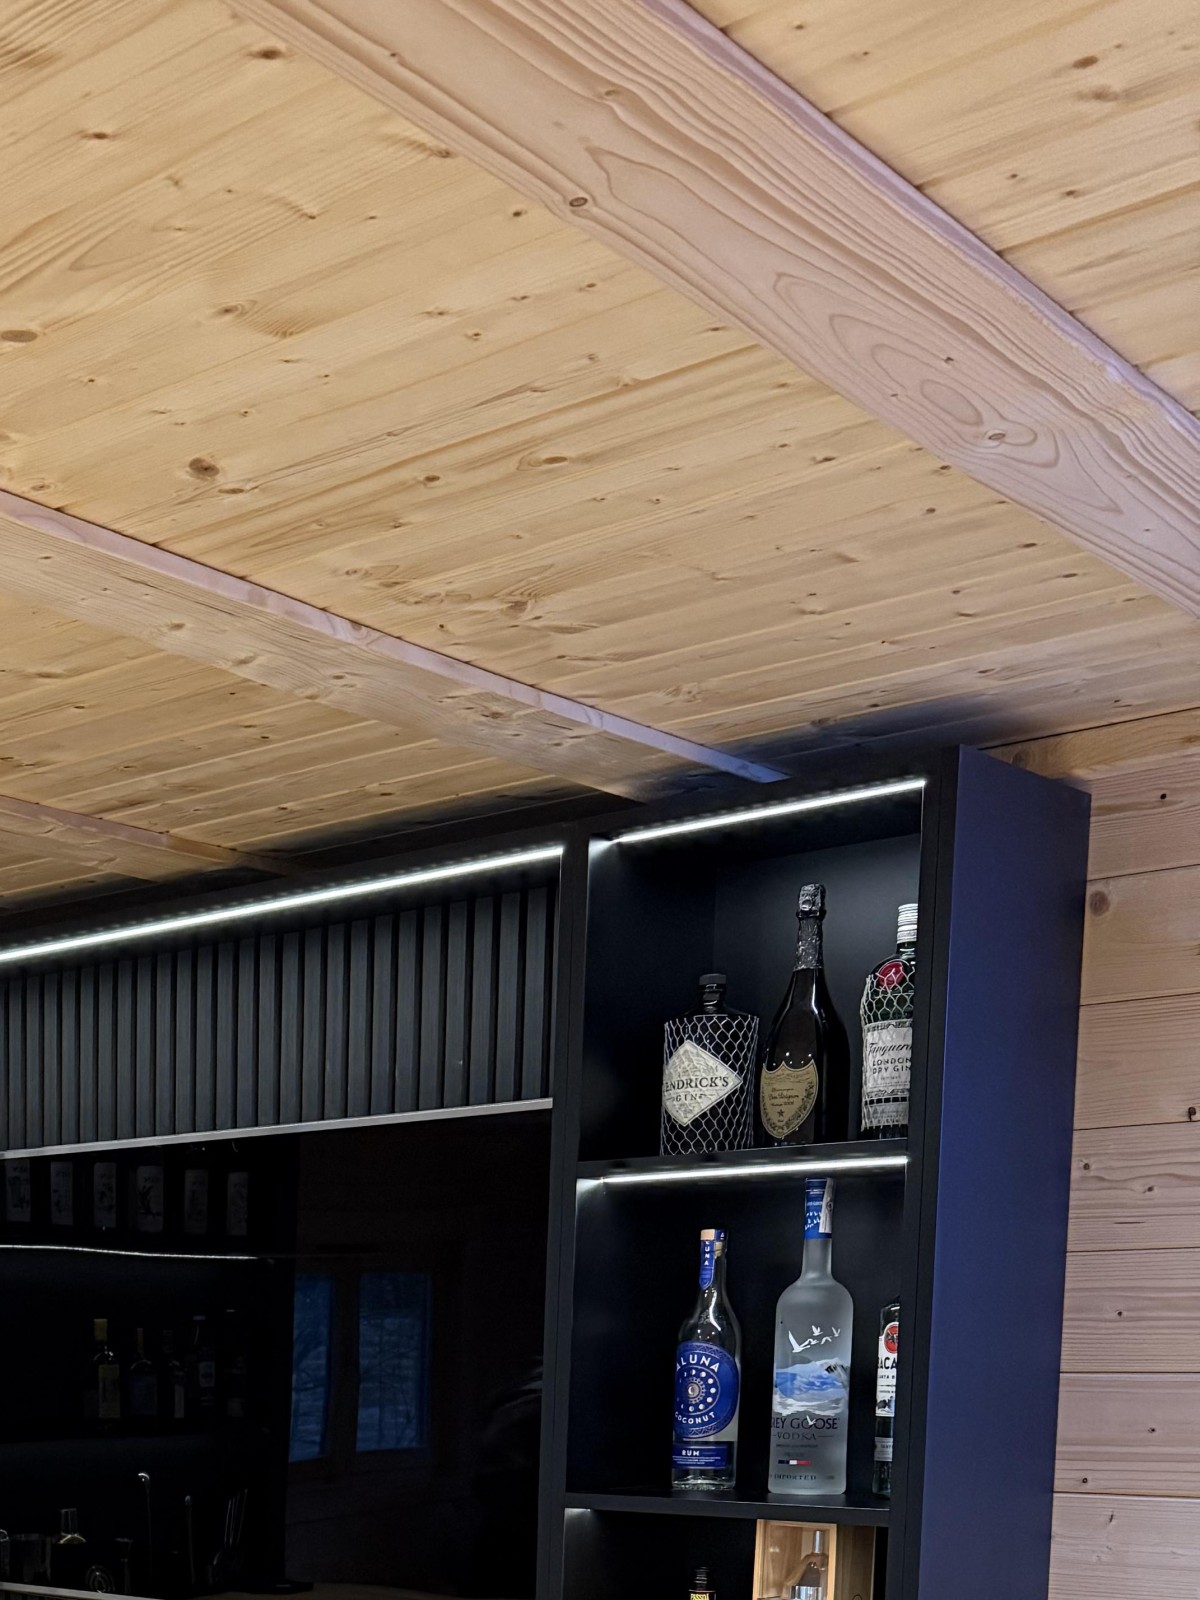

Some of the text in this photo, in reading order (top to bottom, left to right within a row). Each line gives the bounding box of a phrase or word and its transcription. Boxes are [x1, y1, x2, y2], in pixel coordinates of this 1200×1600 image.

[872, 1066, 889, 1075] DRY
[676, 1094, 698, 1103] GIN
[674, 1411, 716, 1425] COCONUT
[790, 1417, 838, 1430] GOOSE
[777, 1431, 817, 1441] VODKA
[681, 1449, 700, 1457] RUM
